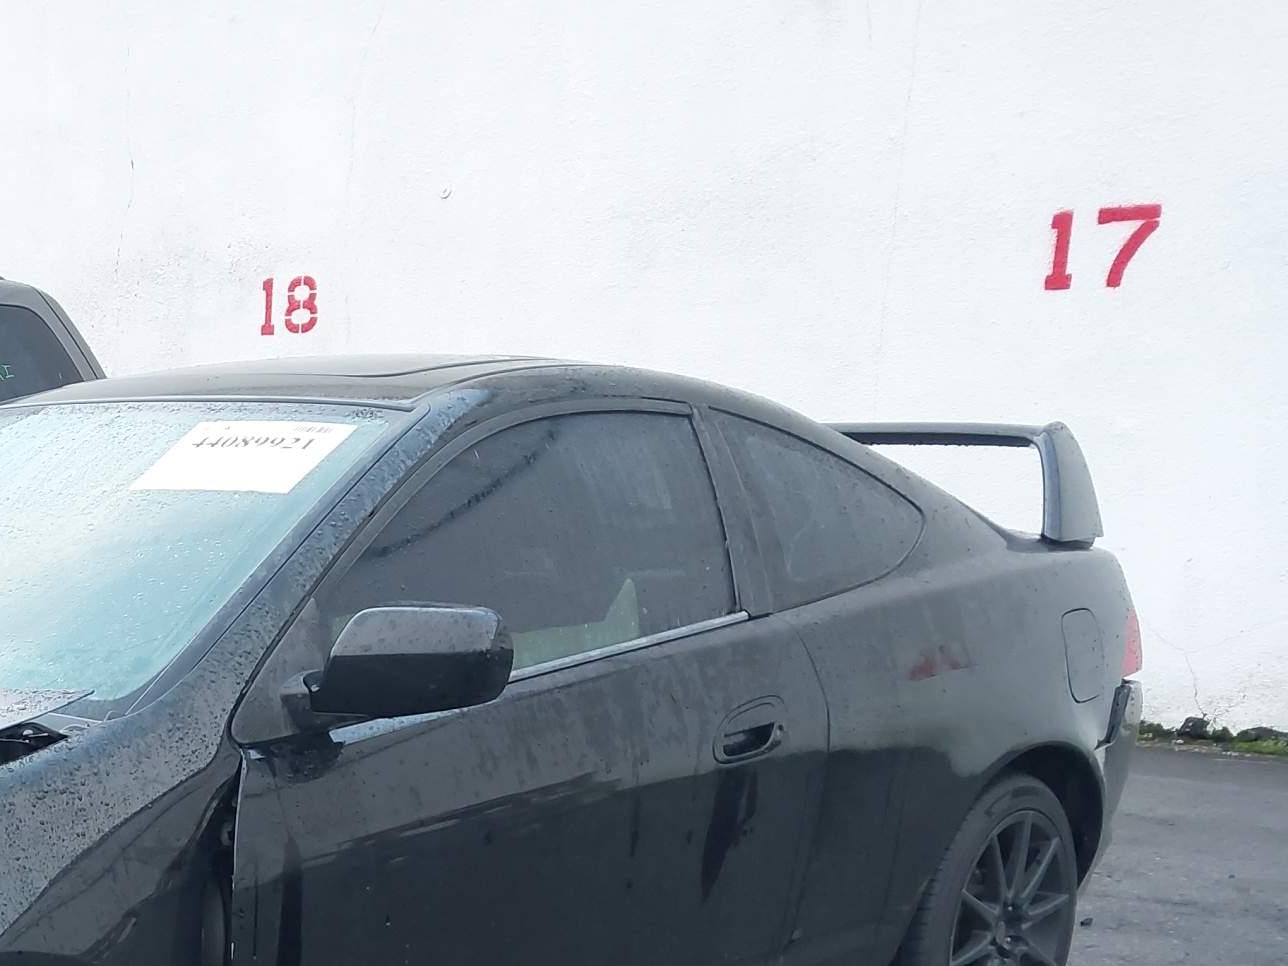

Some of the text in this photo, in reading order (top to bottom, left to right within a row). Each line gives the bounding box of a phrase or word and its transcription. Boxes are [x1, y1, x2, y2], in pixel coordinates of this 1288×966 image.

[1045, 205, 1160, 291] 17
[262, 276, 316, 336] 18
[192, 436, 315, 450] 44089921
